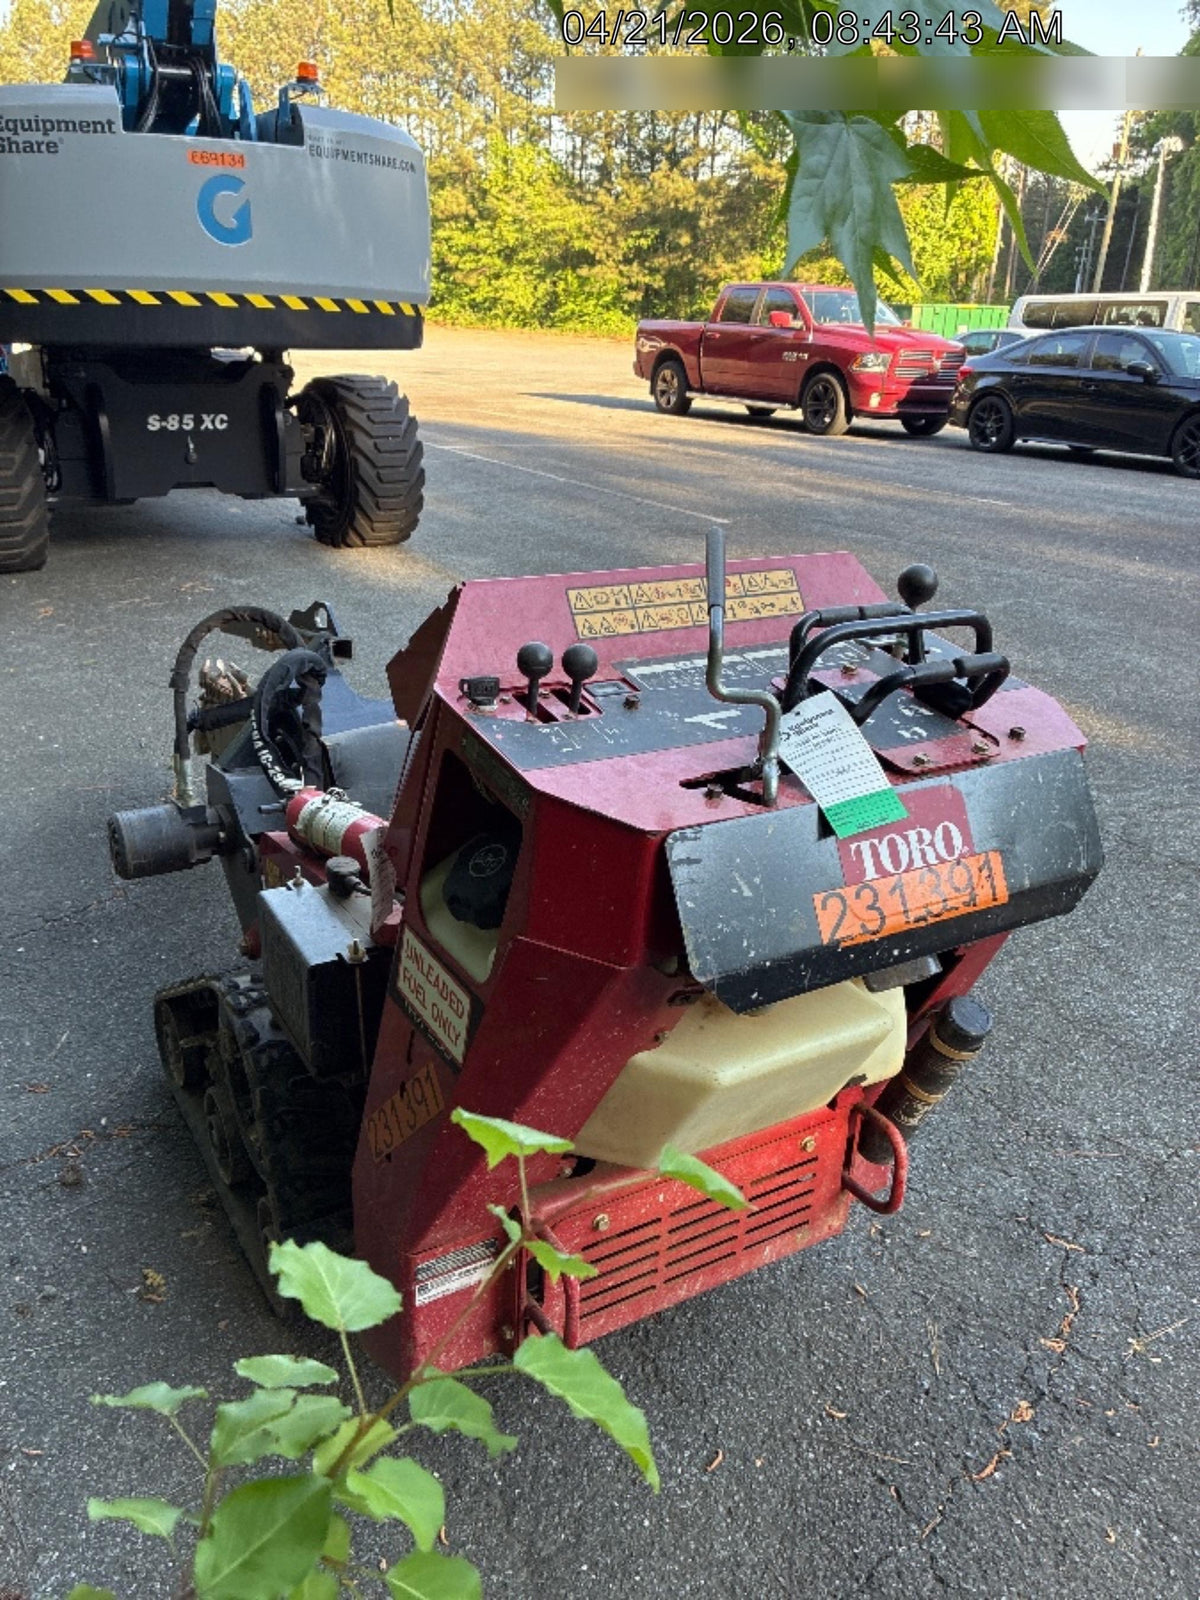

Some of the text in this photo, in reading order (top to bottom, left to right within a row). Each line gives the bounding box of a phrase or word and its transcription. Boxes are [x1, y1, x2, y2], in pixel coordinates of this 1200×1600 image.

[146, 413, 229, 431] S-85 XC
[850, 821, 963, 881] TORO
[820, 853, 999, 946] 231391
[402, 966, 462, 1047] FUEL ONLY
[405, 937, 465, 1019] UNLEADED
[366, 1063, 441, 1159] 231391
